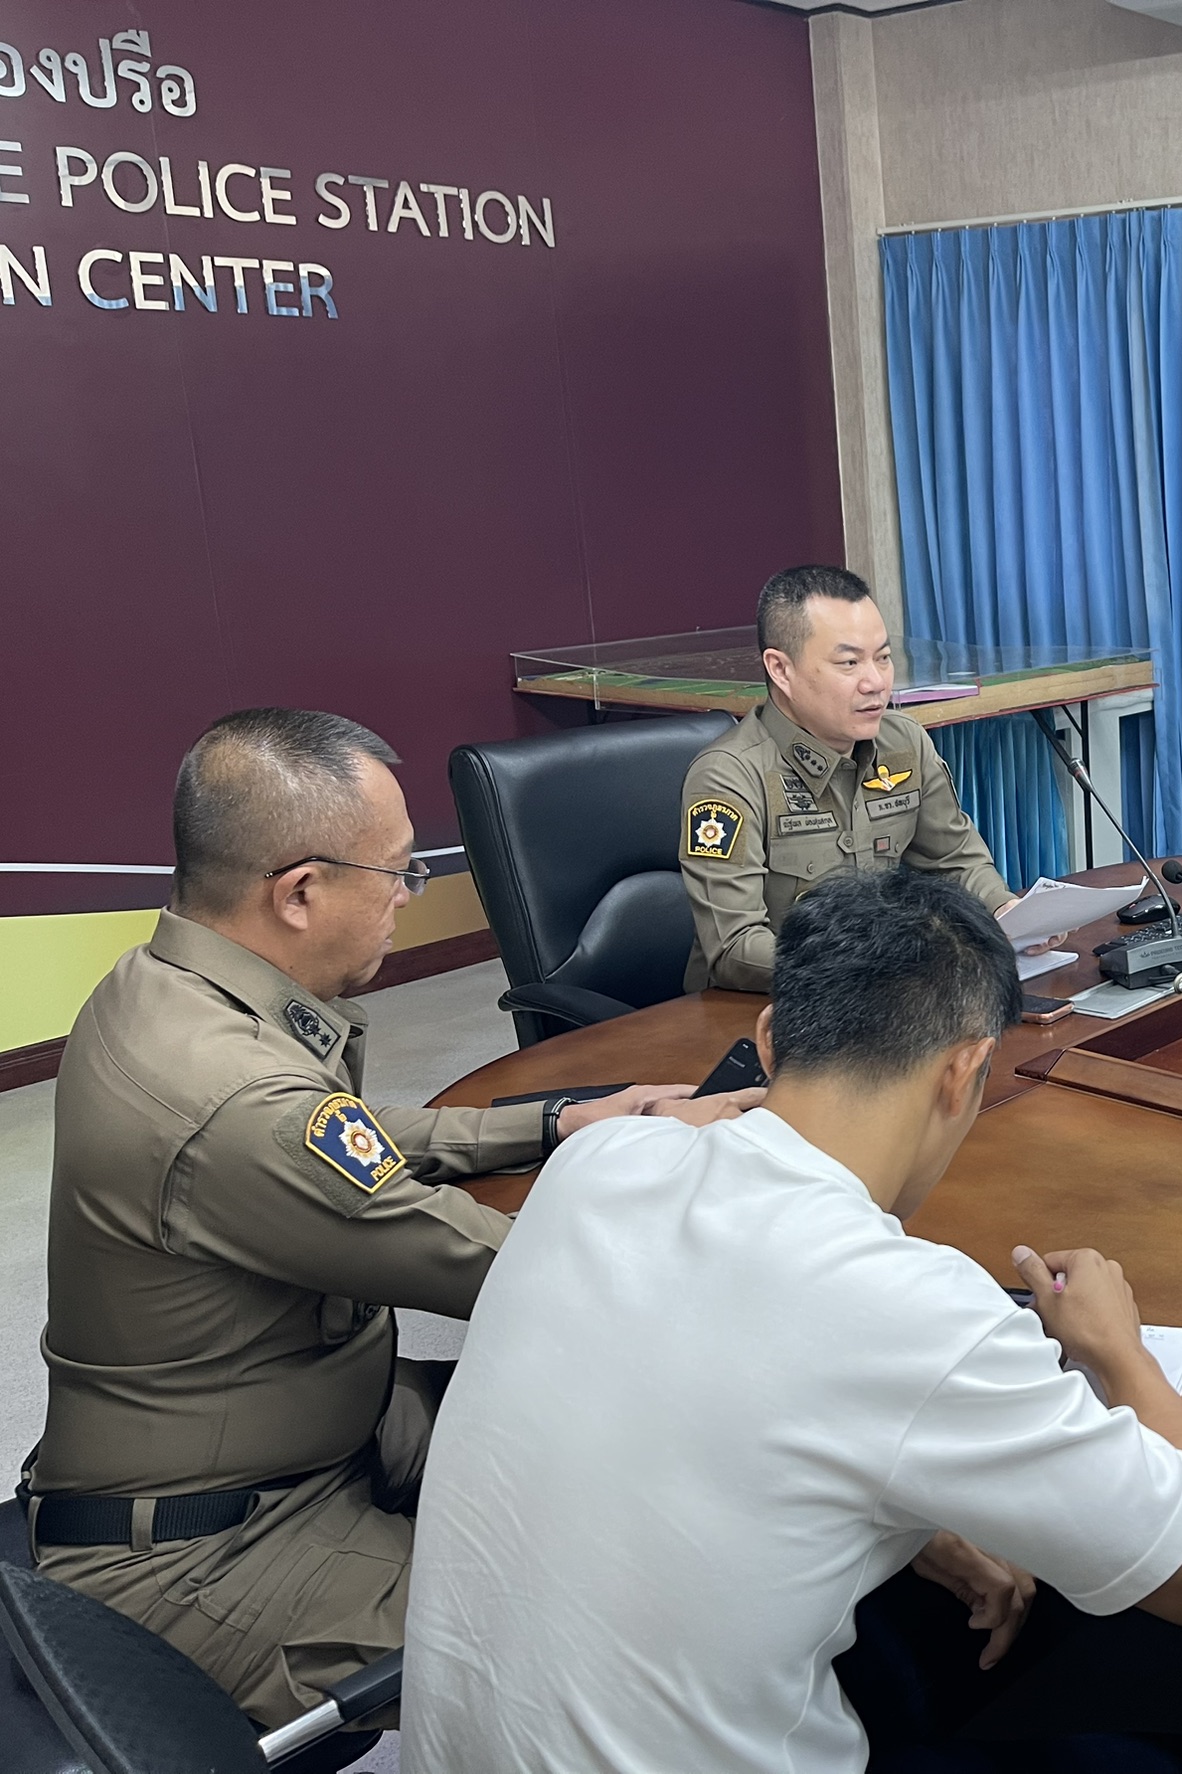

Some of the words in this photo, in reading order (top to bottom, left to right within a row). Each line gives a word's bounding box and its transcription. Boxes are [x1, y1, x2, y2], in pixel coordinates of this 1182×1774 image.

[55, 146, 298, 226] POLICE
[314, 172, 556, 248] STATION
[0, 244, 53, 307] N
[77, 248, 339, 320] CENTER
[694, 845, 723, 855] POLICE
[370, 1156, 396, 1181] POLICE
